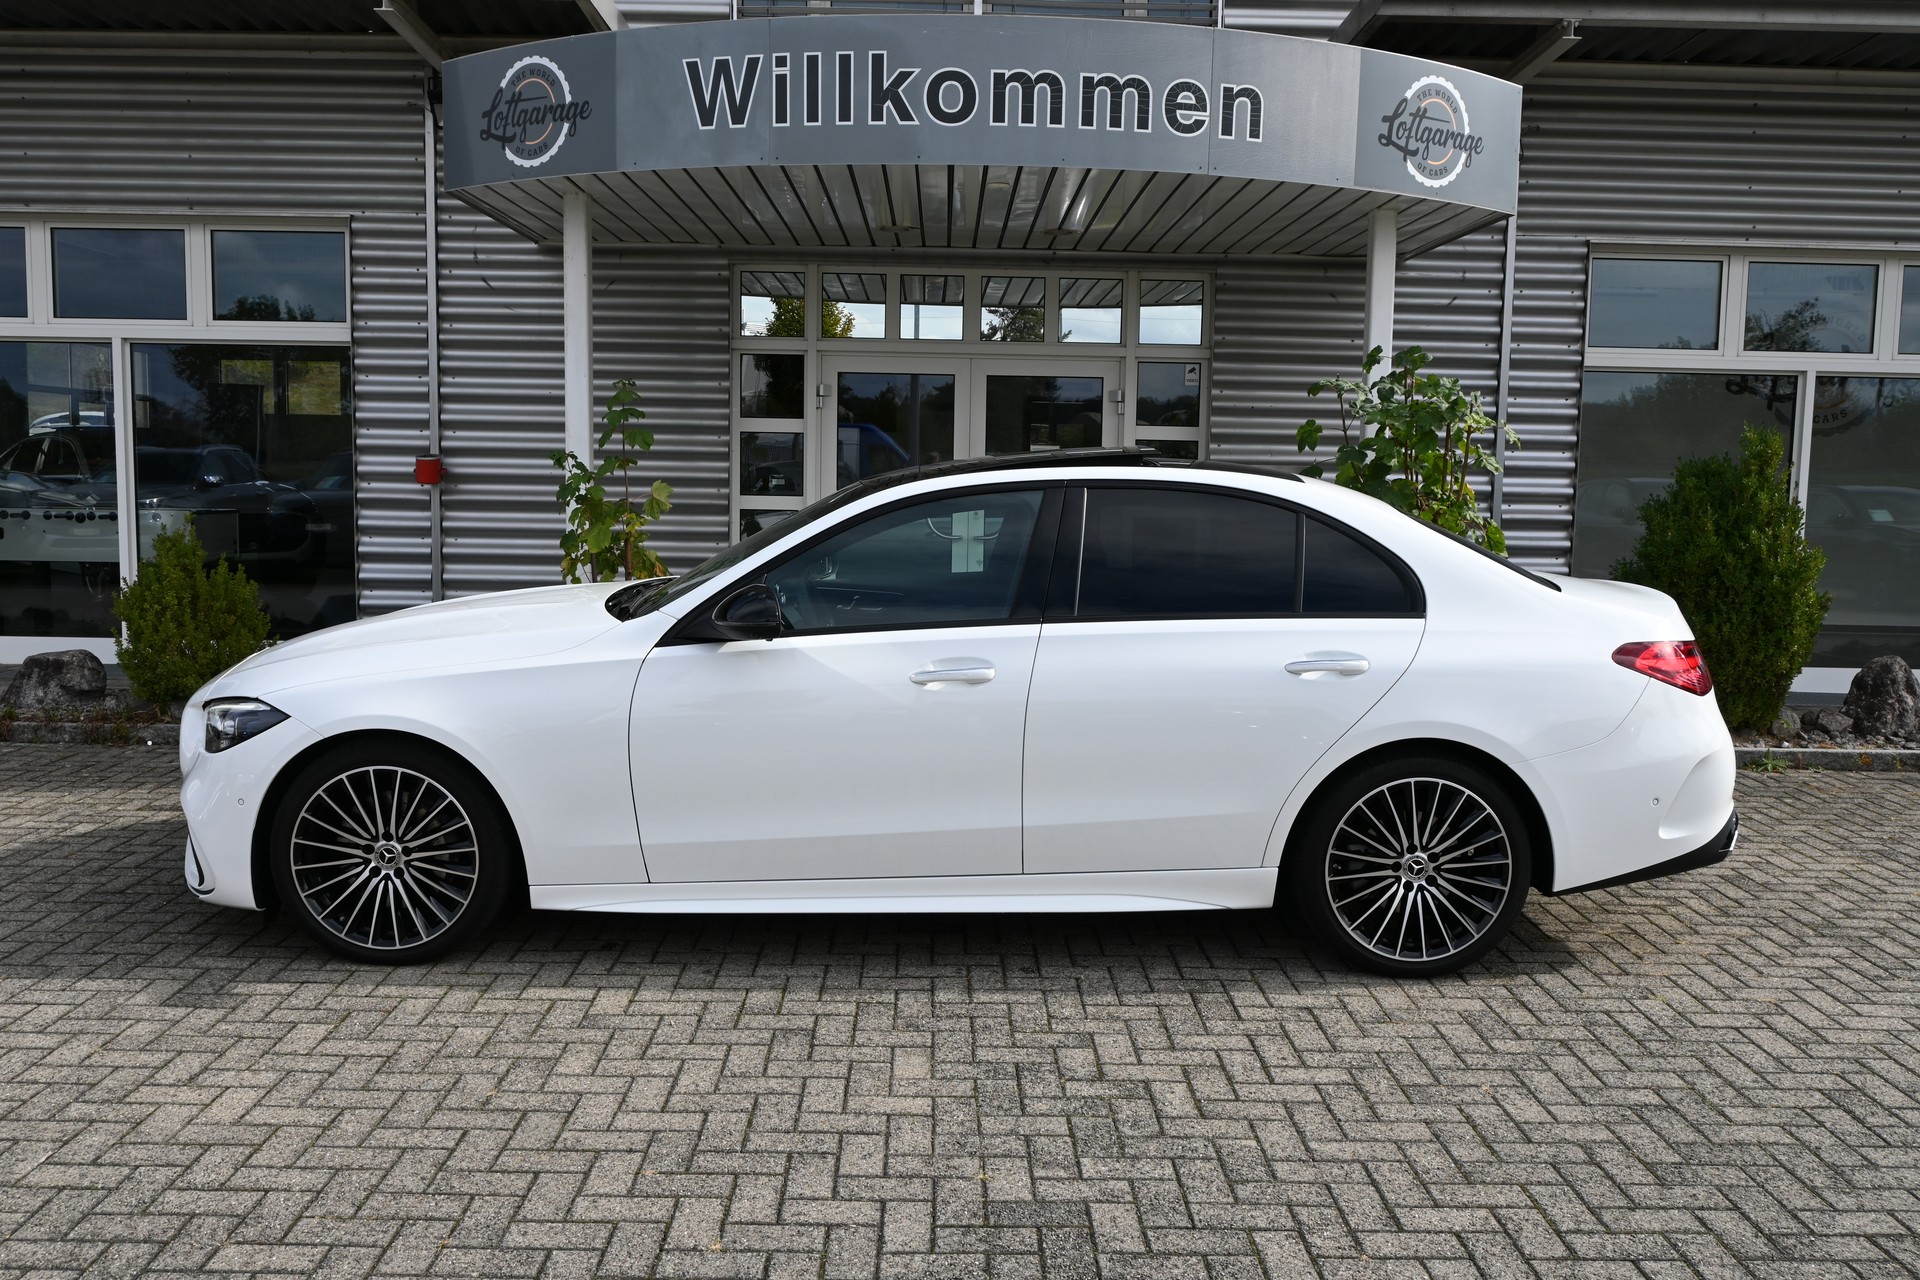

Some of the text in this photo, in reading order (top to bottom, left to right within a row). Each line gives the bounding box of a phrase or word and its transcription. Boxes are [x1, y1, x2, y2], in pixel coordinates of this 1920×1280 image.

[511, 68, 556, 88] THE WORLD
[682, 50, 1264, 143] Willkommen
[1416, 88, 1458, 115] THE WORLD
[480, 86, 592, 151] Loftgarage
[1378, 98, 1485, 168] Loftgarage
[515, 142, 549, 157] OF CARS
[1417, 162, 1448, 177] OF CARS
[1813, 408, 1848, 424] CARS
